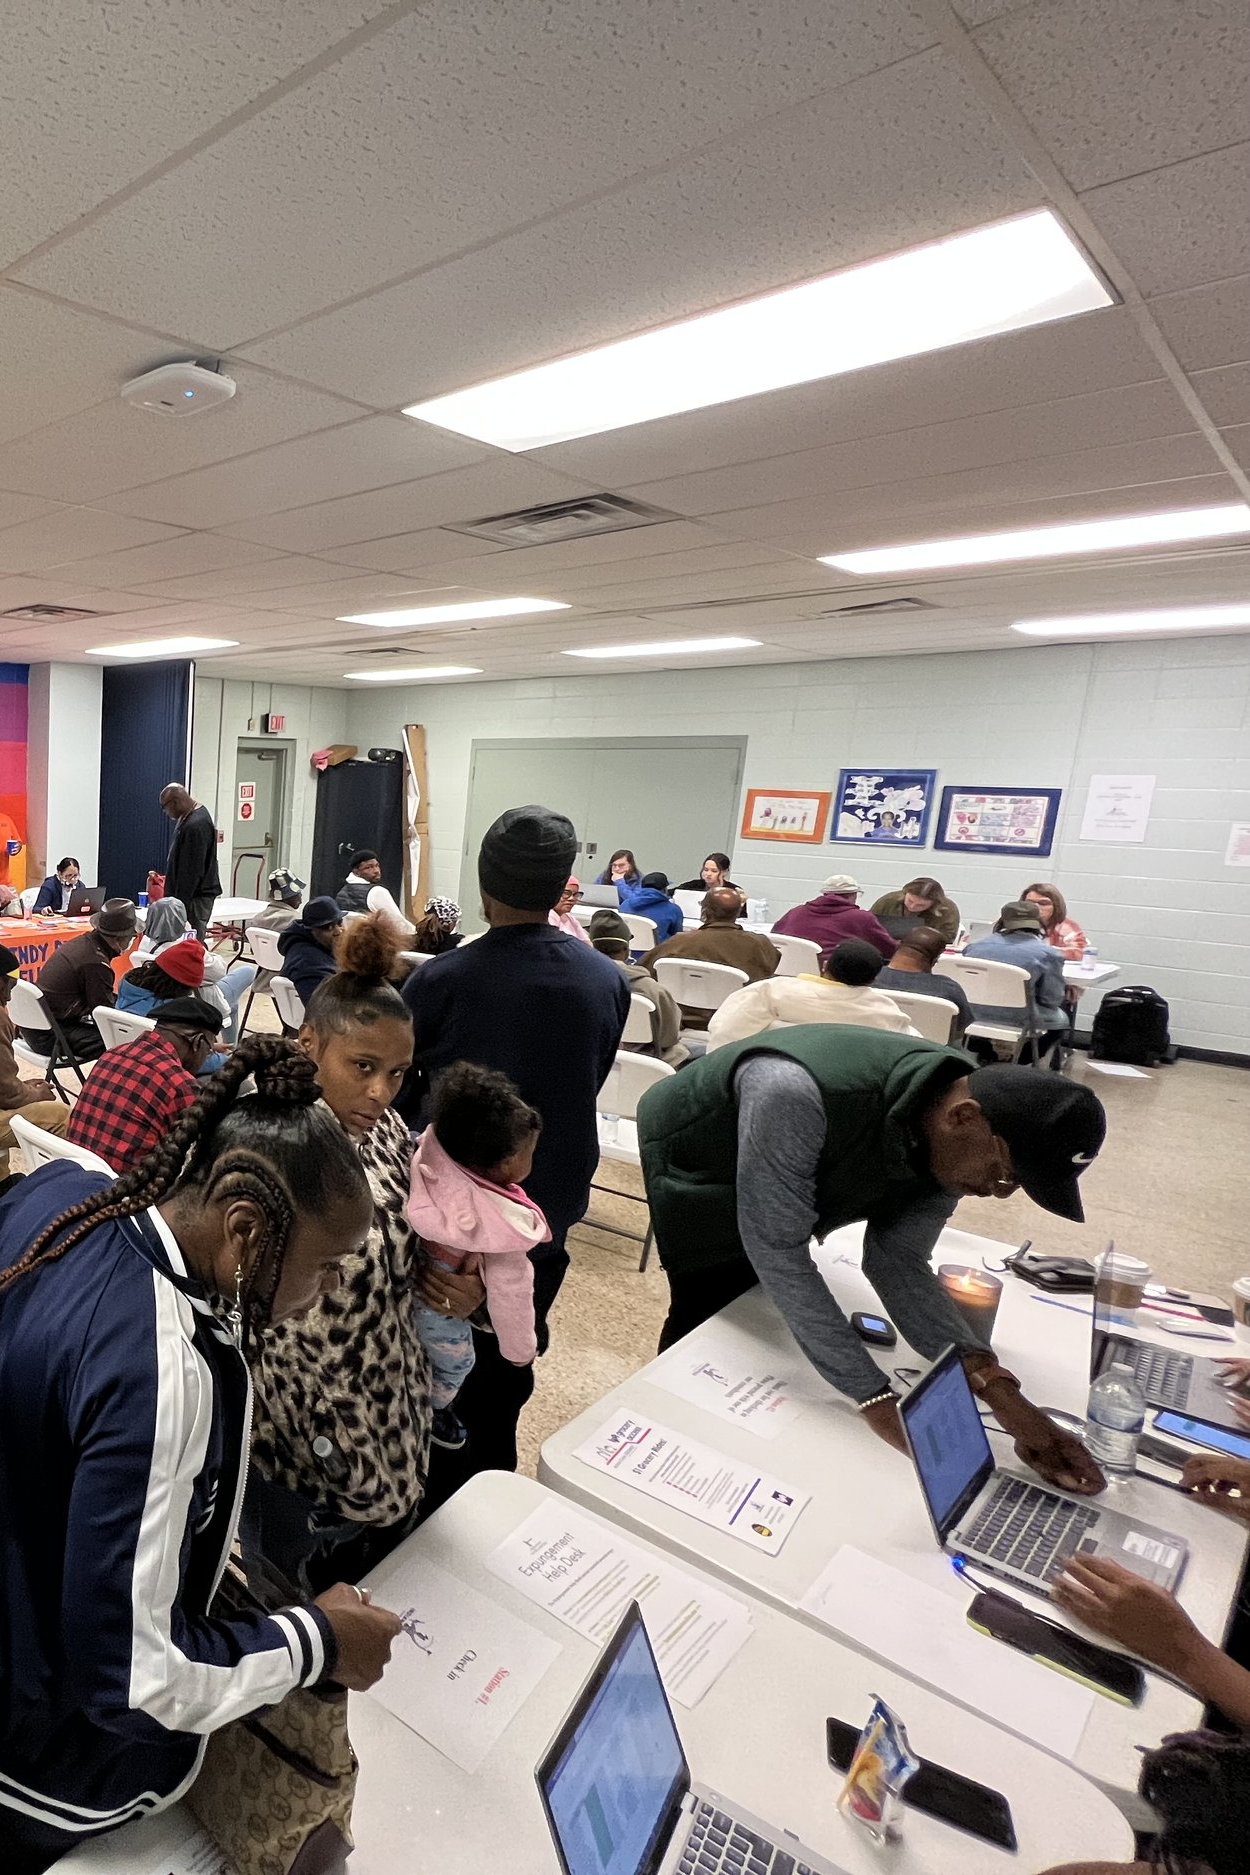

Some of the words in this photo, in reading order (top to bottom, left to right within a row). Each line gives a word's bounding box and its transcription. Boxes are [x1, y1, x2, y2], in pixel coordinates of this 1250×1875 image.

[517, 1531, 576, 1577] Expungement
[541, 1564, 570, 1583] Help
[558, 1546, 587, 1568] Desk
[446, 1669, 461, 1682] in
[453, 1649, 478, 1674] Check
[483, 1666, 511, 1695] Station
